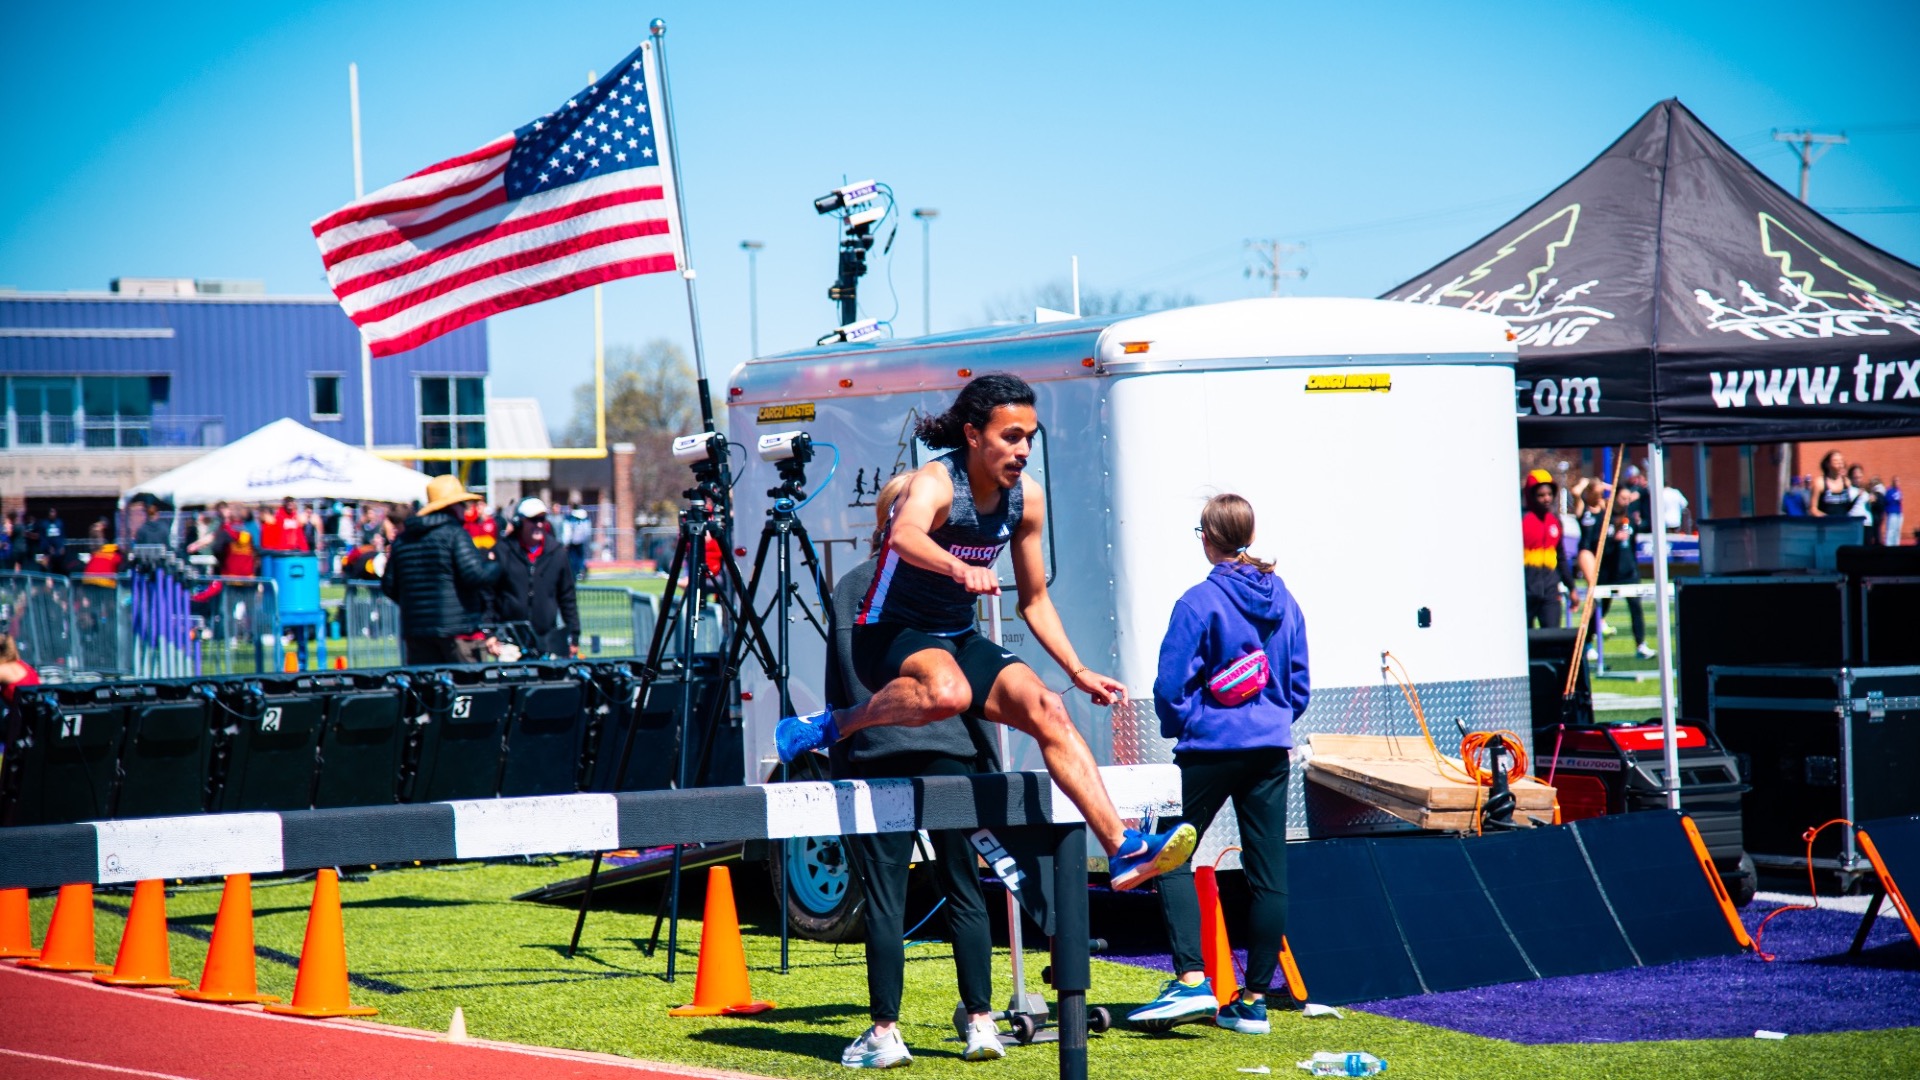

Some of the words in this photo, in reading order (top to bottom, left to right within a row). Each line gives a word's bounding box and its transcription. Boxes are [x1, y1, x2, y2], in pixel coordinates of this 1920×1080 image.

[1512, 317, 1600, 346] ING
[1719, 315, 1890, 340] TRXC
[1306, 374, 1345, 389] CARGO
[1345, 373, 1391, 388] MASTER
[1709, 353, 1920, 409] www.trx
[758, 406, 784, 420] CARGO
[784, 402, 815, 418] MASTER
[970, 828, 1027, 892] GILL
